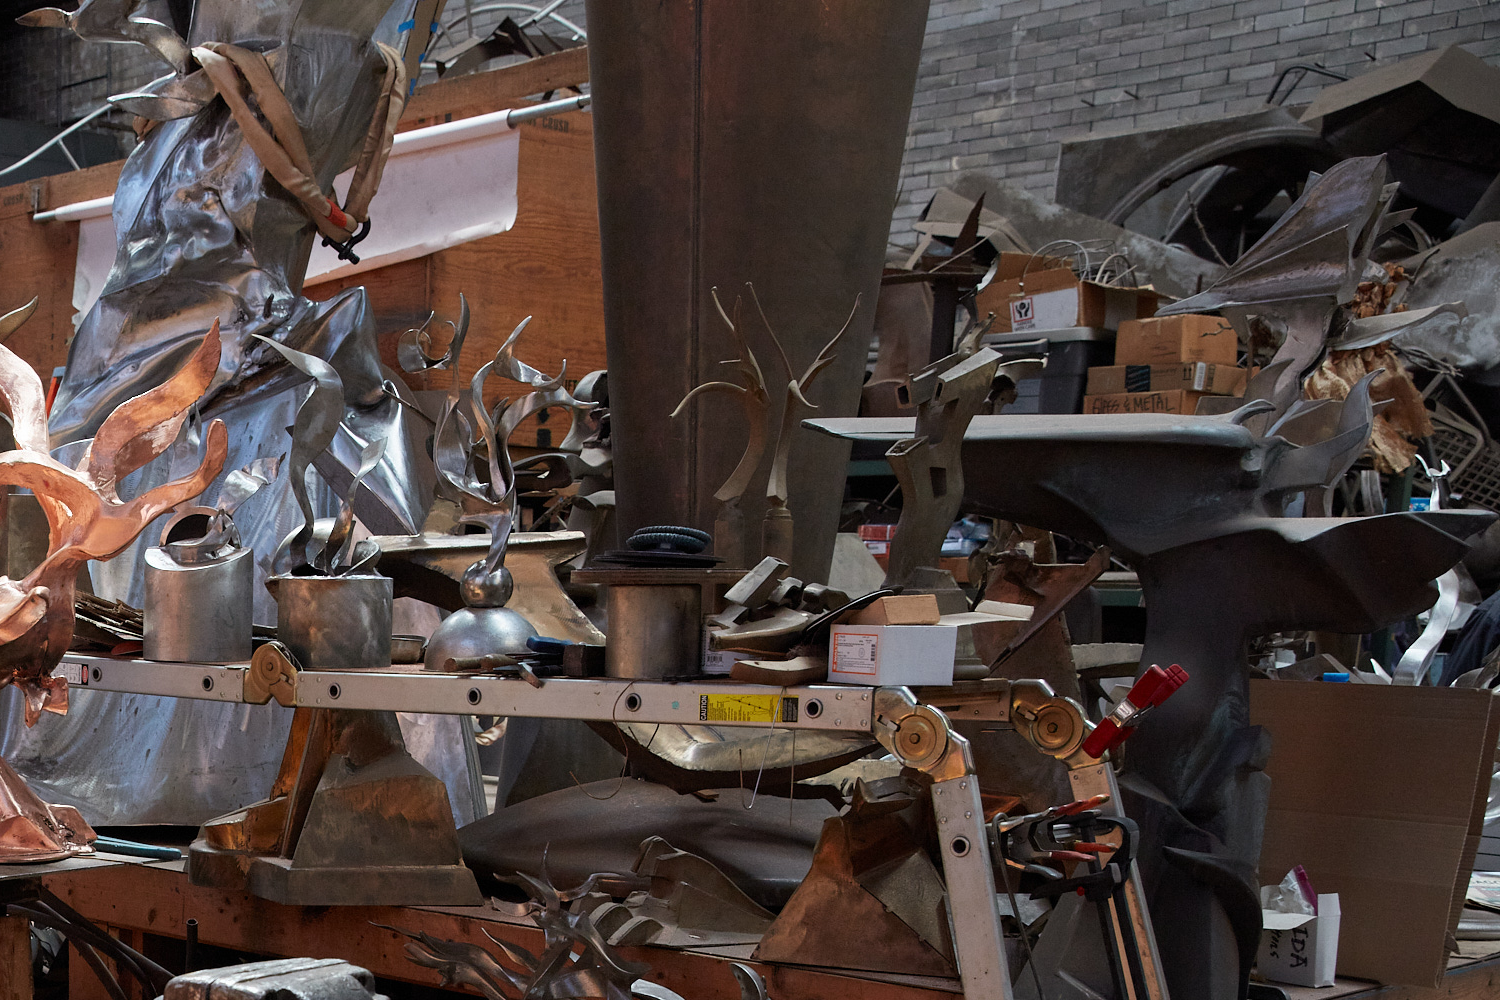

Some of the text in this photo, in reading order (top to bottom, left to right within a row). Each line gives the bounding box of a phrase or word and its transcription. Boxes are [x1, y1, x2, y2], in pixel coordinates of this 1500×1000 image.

[1133, 393, 1176, 412] METAL
[700, 695, 708, 721] CAUTION
[1290, 927, 1309, 968] IDA
